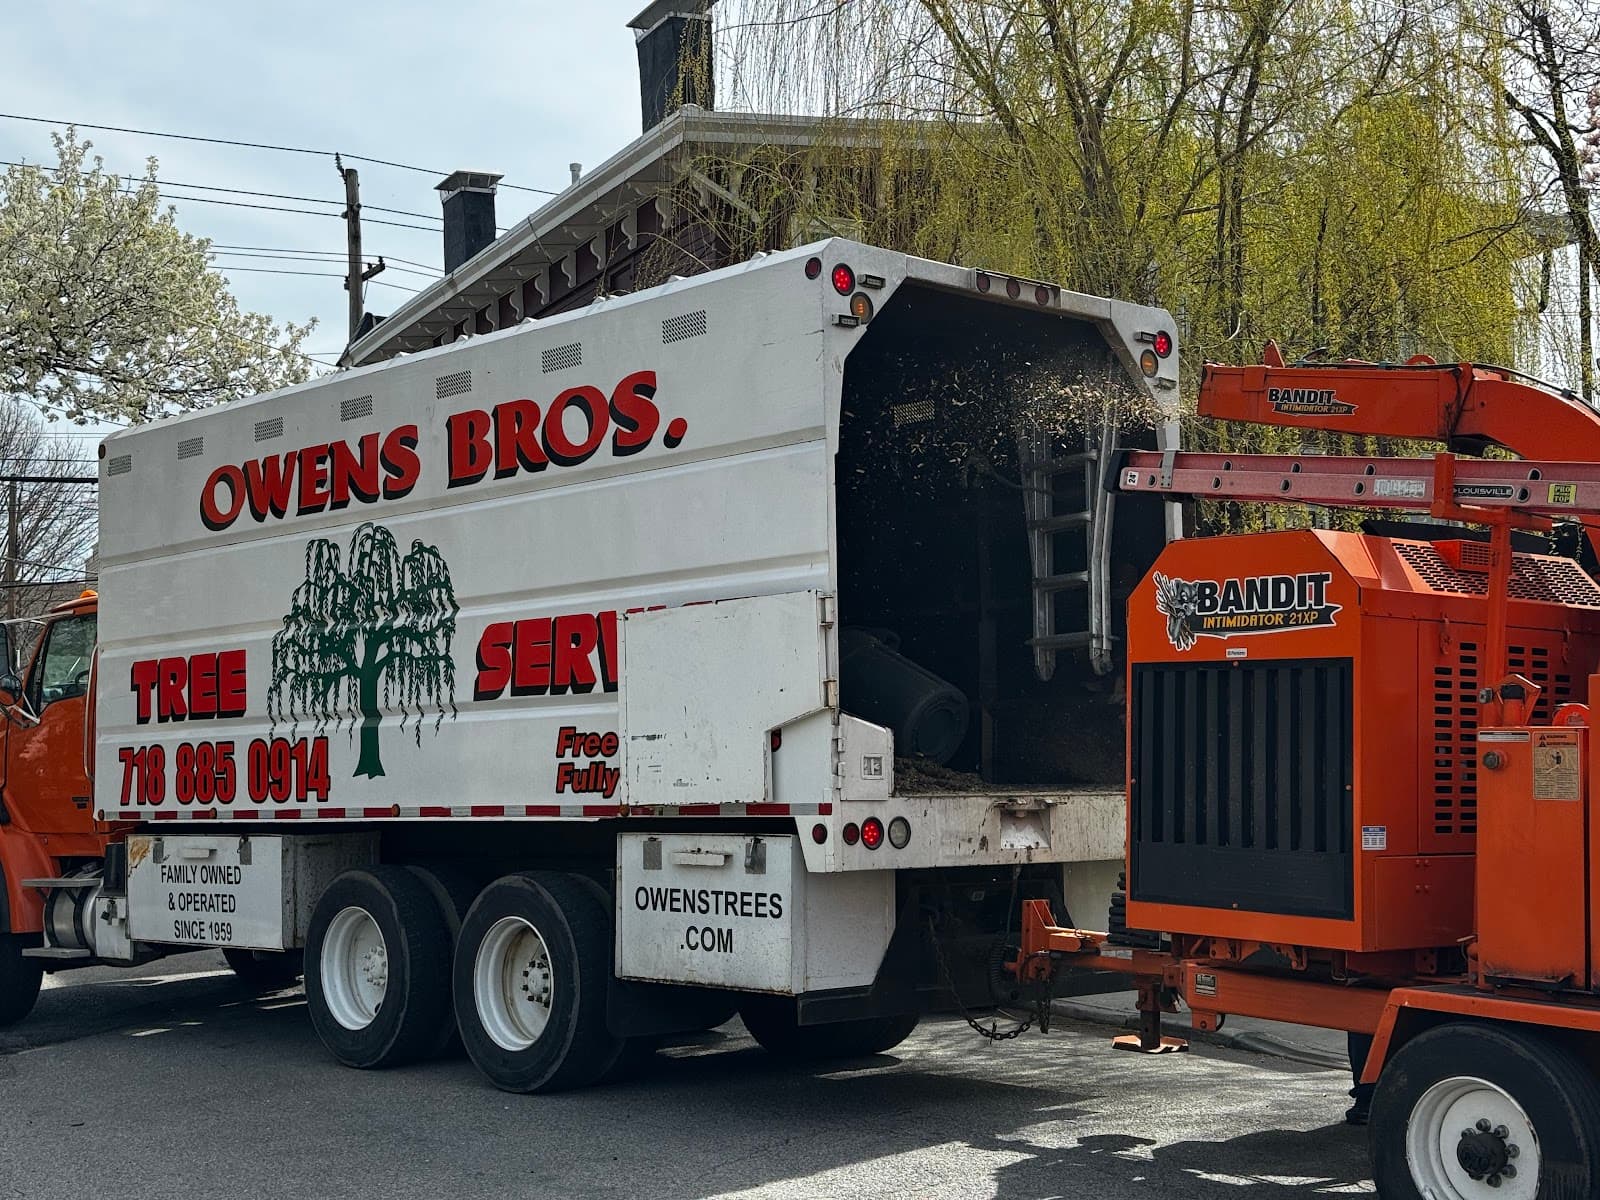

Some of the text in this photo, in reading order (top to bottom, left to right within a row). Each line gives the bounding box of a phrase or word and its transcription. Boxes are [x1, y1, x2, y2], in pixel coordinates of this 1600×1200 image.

[1268, 388, 1335, 404] BANDIT
[1281, 403, 1328, 413] INTIMIDATOR
[200, 370, 688, 531] OWENS BROS.
[1455, 487, 1513, 497] LOUISVILLE
[1553, 495, 1571, 504] TOP
[1554, 485, 1571, 494] PRO
[1197, 572, 1330, 614] BANDIT
[1203, 611, 1319, 629] INTIMIDATOR 21XP
[131, 649, 247, 724] TREE
[556, 726, 619, 758] Free
[119, 736, 331, 806] 718 885 0914
[556, 761, 620, 799] Fully
[161, 865, 242, 885] FAMILY OWNED
[168, 892, 236, 913] & OPERATED
[635, 886, 782, 919] OWENSTREES
[174, 920, 232, 941] SINCE 1959
[680, 926, 733, 953] .COM
